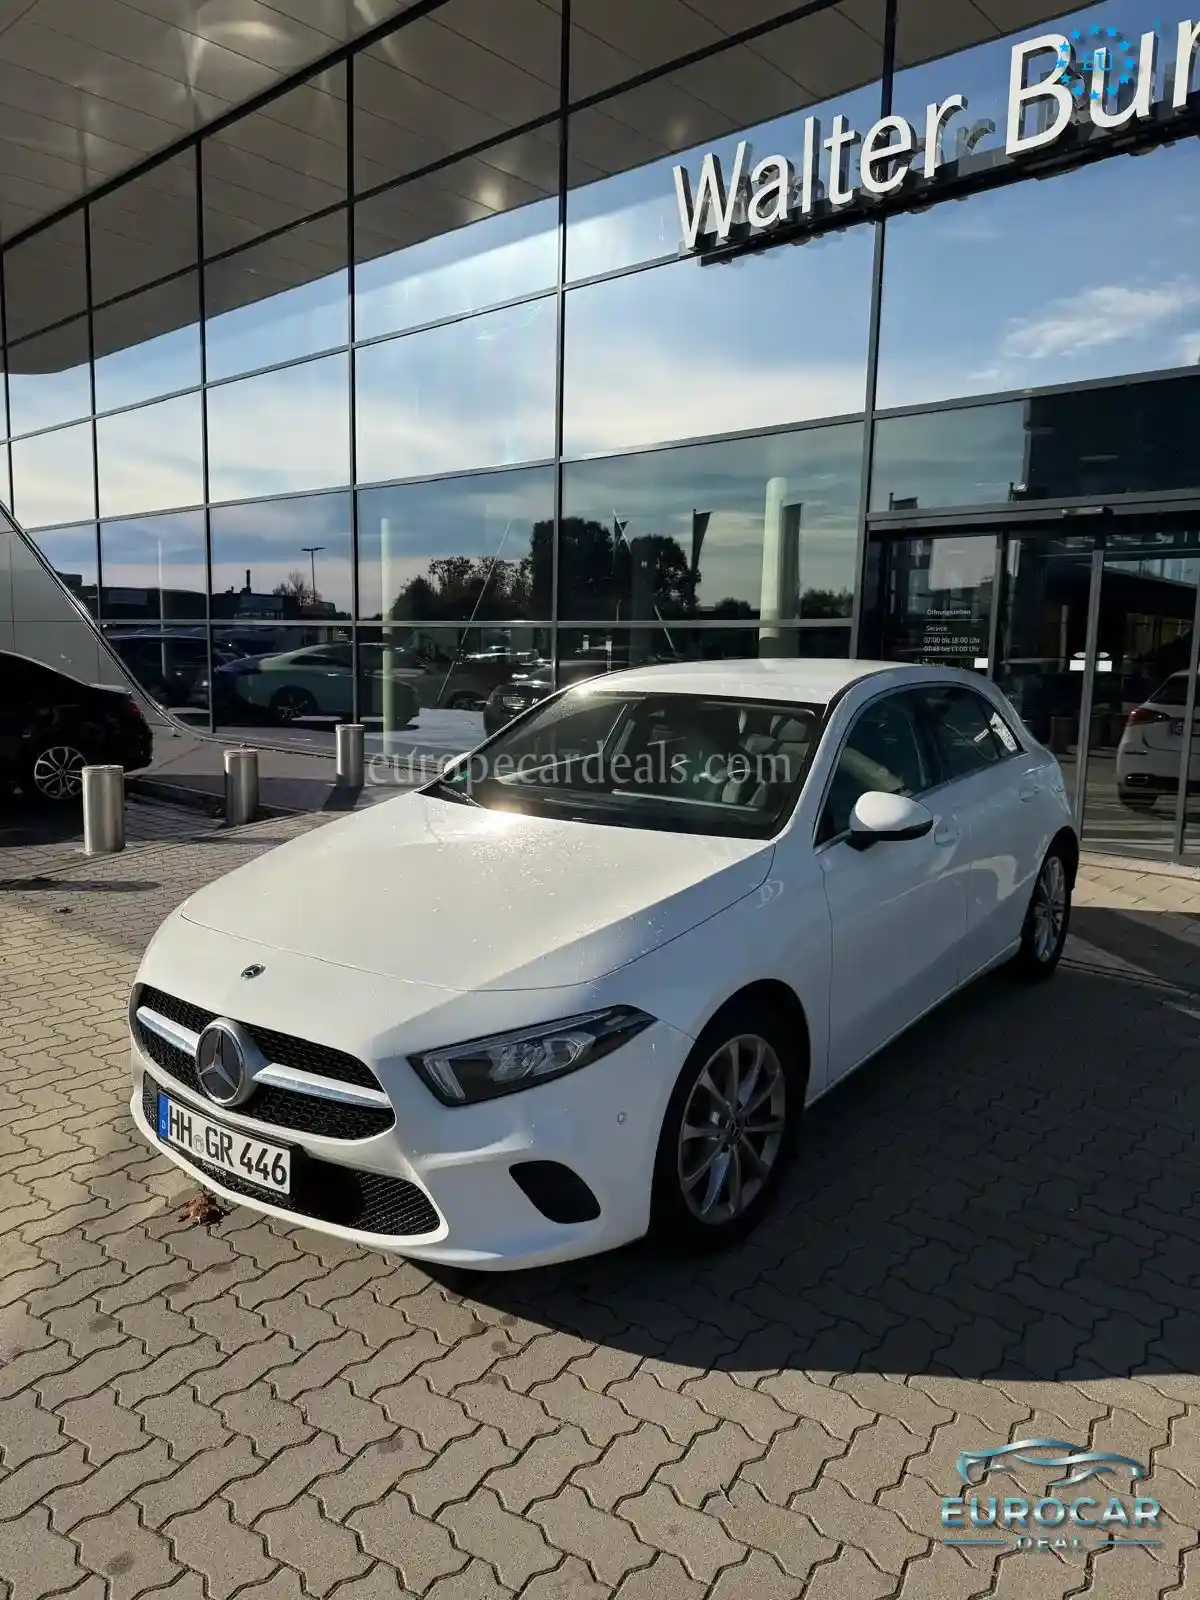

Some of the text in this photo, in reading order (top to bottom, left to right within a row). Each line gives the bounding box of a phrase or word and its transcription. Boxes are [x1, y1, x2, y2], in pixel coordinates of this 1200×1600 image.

[673, 94, 968, 251] Walter
[926, 624, 948, 632] Service
[169, 1104, 288, 1186] HH GR 446
